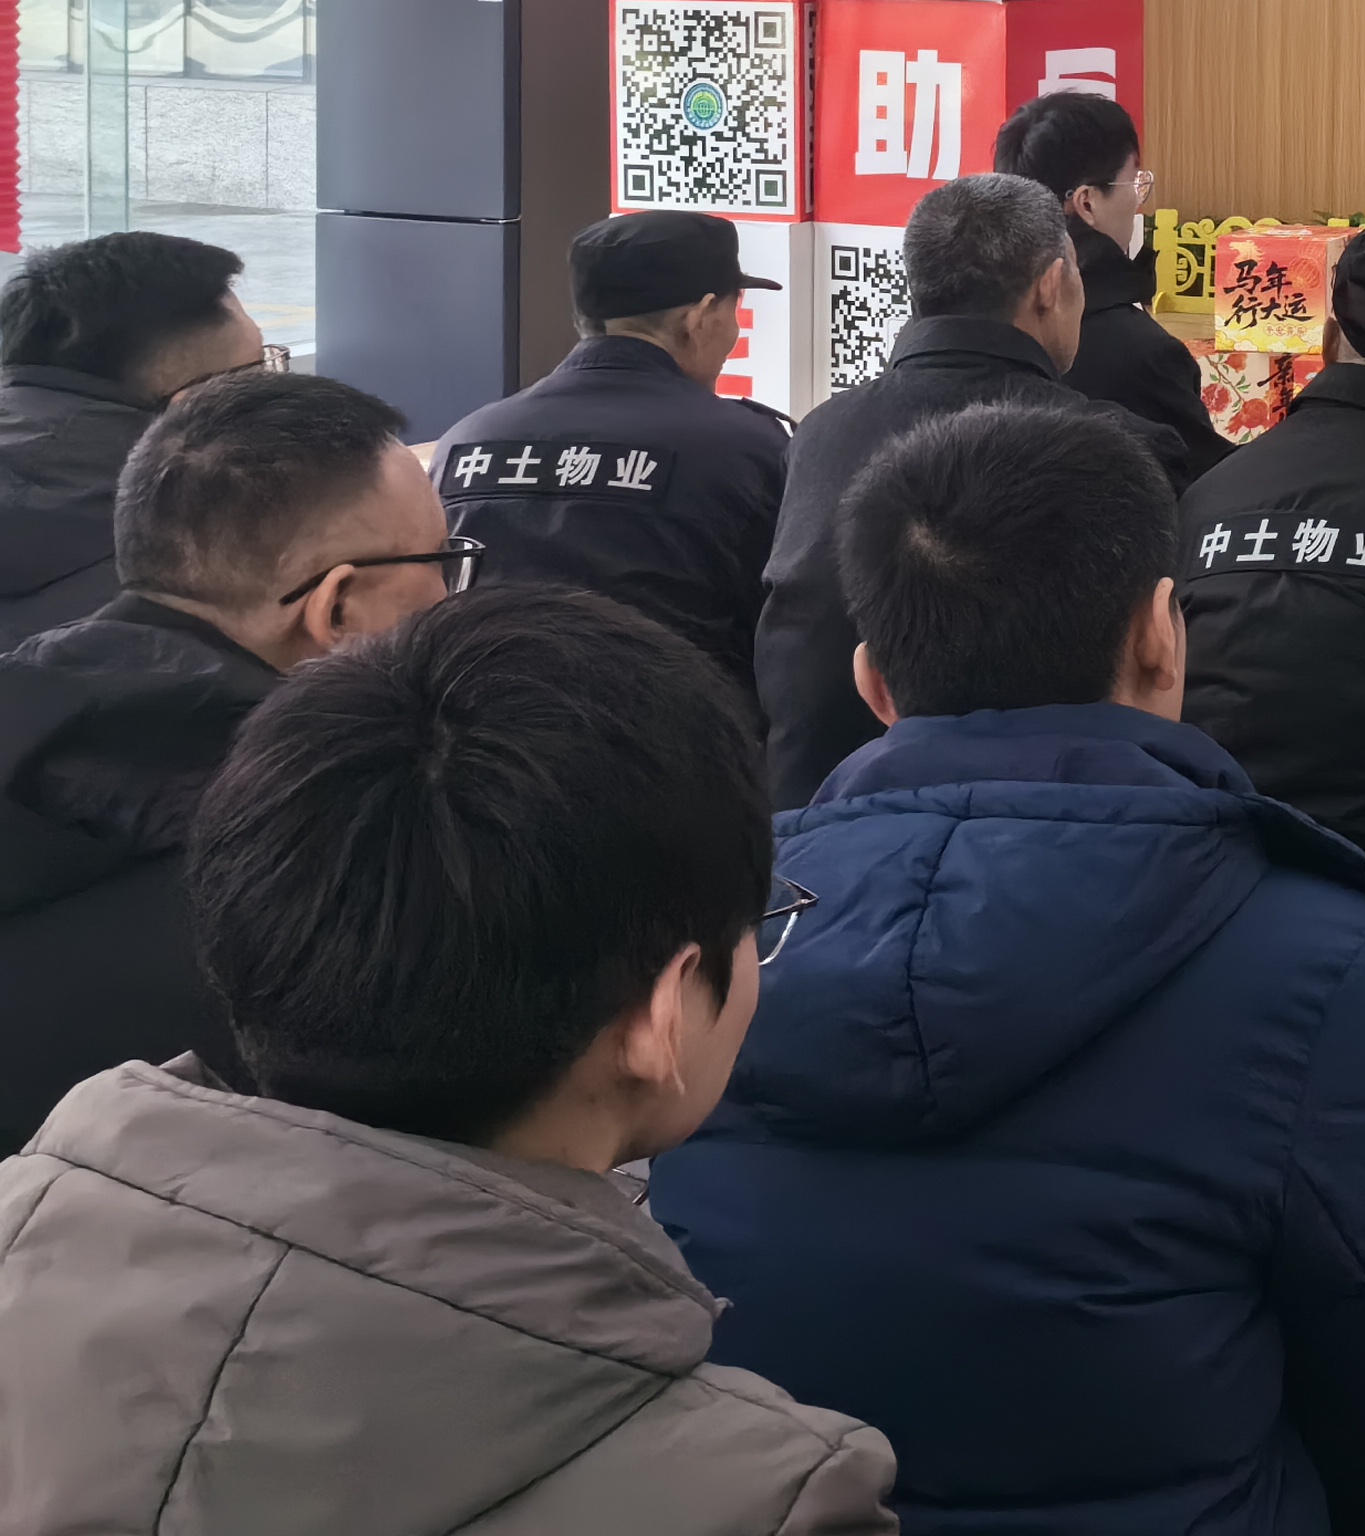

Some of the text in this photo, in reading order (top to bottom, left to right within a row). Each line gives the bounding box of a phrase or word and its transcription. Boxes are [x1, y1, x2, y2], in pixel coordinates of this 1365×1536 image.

[855, 49, 962, 181] 助
[1223, 259, 1293, 298] 马年
[1224, 293, 1316, 331] 行大运
[454, 445, 658, 491] 中土物业
